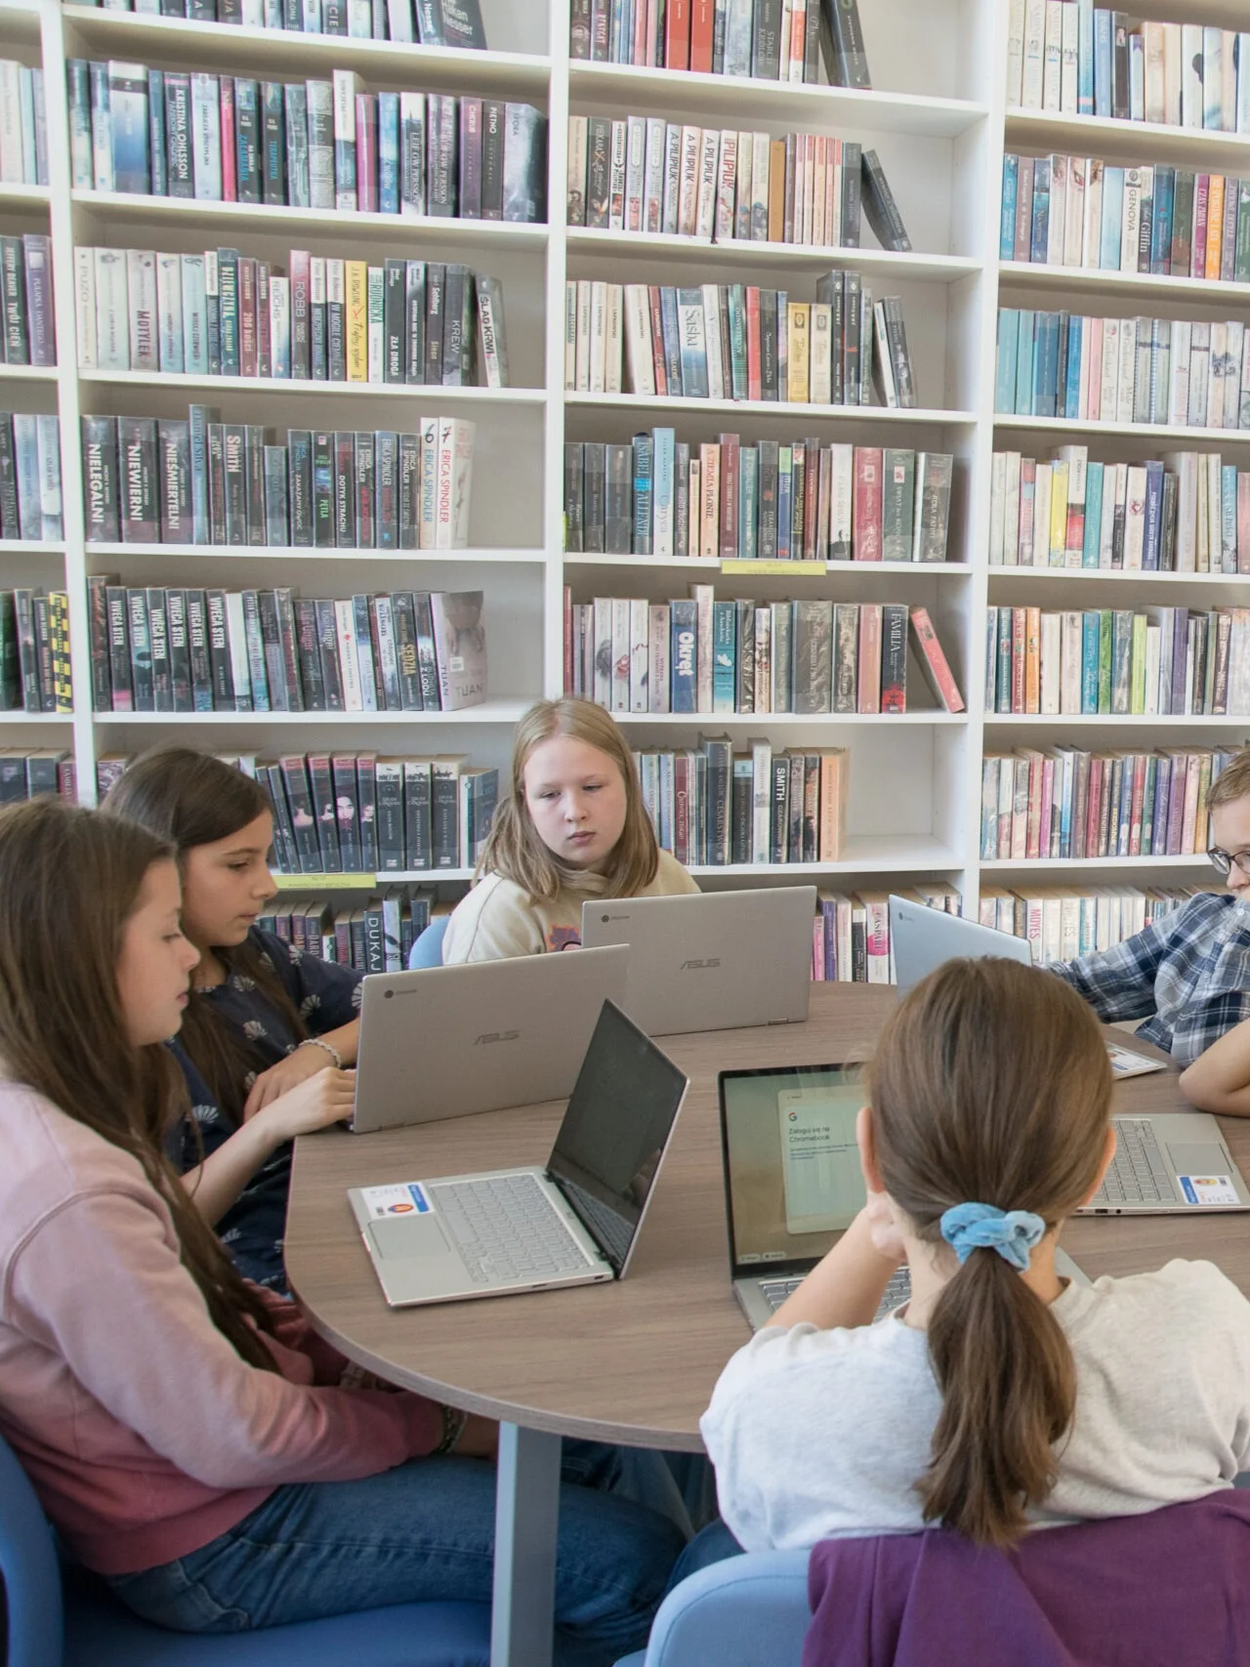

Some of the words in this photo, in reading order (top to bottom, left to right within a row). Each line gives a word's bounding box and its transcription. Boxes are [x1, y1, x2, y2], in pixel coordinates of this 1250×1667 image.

[422, 3, 434, 33] Nesser
[442, 16, 474, 36] Nesser
[176, 90, 186, 131] KRISTINA
[178, 134, 188, 178] OHLSSON
[269, 141, 277, 180] TERAPEUTKA
[669, 143, 678, 180] PILIPIUK
[685, 145, 695, 181] PILIPIUK
[703, 148, 714, 184] PILIPIUK
[722, 141, 735, 190] PILIPIUK
[1198, 188, 1207, 207] CZAS
[1197, 208, 1206, 227] ZMIAN
[1140, 222, 1150, 252] Giffin
[5, 247, 17, 271] JEFFERY
[32, 278, 42, 308] PUŁAPKA
[80, 267, 89, 302] PUZO
[296, 282, 305, 317] ROBB
[7, 302, 20, 324] TWÓJ
[370, 284, 382, 323] RUDNICKA
[477, 297, 490, 325] ŚLAD
[34, 311, 44, 344] DANTEGO
[137, 311, 151, 357] MOTYLEK
[244, 313, 252, 327] 206
[331, 313, 340, 336] MOGILE
[685, 310, 701, 346] Sasha
[9, 327, 21, 347] CIEŃ
[390, 336, 398, 349] ZŁA
[452, 320, 460, 353] KREW
[482, 325, 495, 354] KRWI
[390, 351, 398, 376] DROGA
[192, 413, 202, 445] Daniel
[194, 447, 203, 472] Silva
[226, 435, 241, 473] SMITH
[383, 439, 391, 455] ERICA
[637, 442, 649, 477] ISABEL
[383, 457, 391, 485] SPINDLER
[425, 449, 434, 476] ERICA
[442, 450, 450, 478] ERICA
[89, 444, 103, 522] NIELEGALNI
[127, 446, 143, 521] NIEWIERNI
[165, 444, 180, 529] NIEŚMIERTELNI
[424, 479, 433, 522] SPINDLER
[441, 480, 450, 523] SPINDLER
[637, 494, 649, 537] ALLENDE
[111, 601, 121, 626] VIVECA
[131, 596, 143, 625] VIVECA
[151, 609, 164, 637] VIVECA
[169, 597, 182, 625] VIVECA
[191, 602, 201, 627] VIVECA
[210, 597, 222, 626] VIVECA
[378, 604, 387, 636] wilson
[113, 628, 124, 645] STEN
[133, 627, 145, 646] STEN
[172, 627, 184, 647] STEN
[192, 629, 202, 646] STEN
[213, 628, 224, 648] STEN
[302, 625, 313, 651] Unger
[890, 614, 902, 652] FAMILIA
[154, 639, 166, 659] STEN
[675, 632, 694, 676] Okręt
[776, 768, 785, 801] SMITH
[874, 913, 884, 950] CASPARI
[1030, 909, 1041, 939] MOYES
[369, 918, 381, 970] DUKAJ
[679, 957, 721, 971] ASUS
[473, 1030, 521, 1045] ASUS
